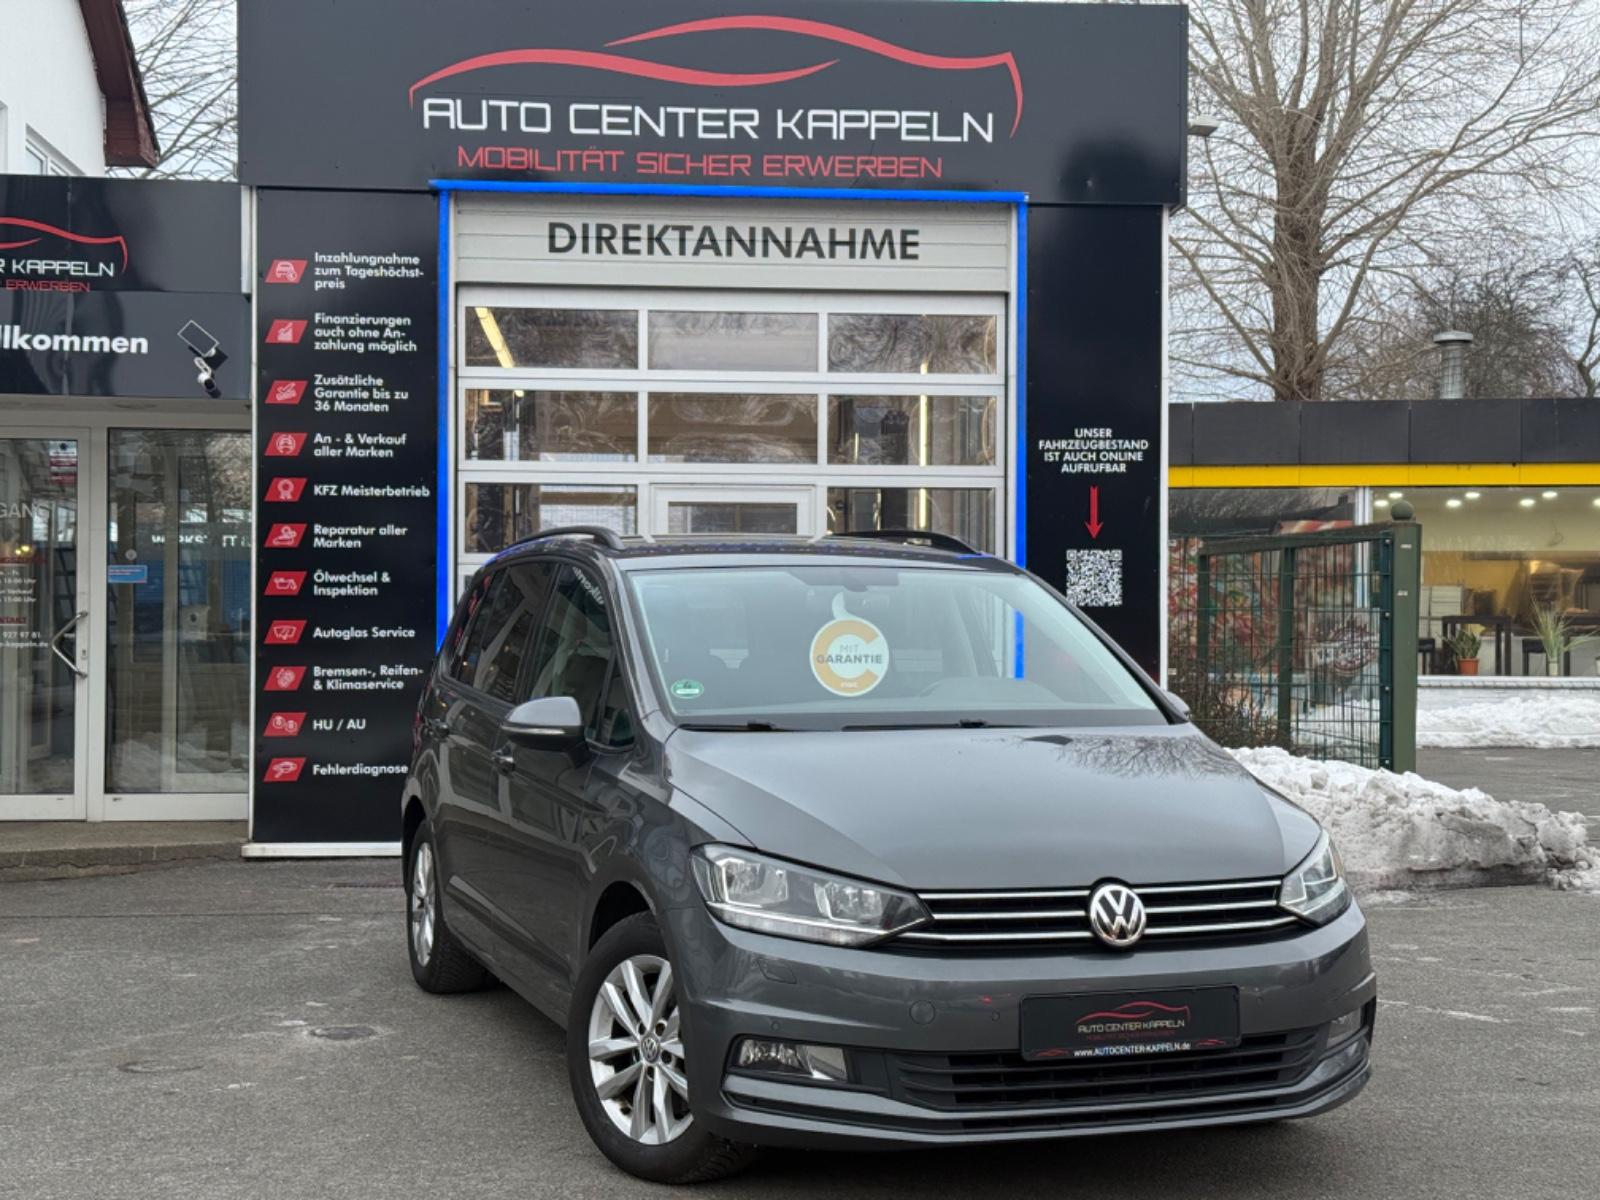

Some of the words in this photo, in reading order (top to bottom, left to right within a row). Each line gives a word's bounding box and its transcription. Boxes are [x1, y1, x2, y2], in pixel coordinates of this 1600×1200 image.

[423, 97, 551, 133] AUTO
[569, 103, 760, 139] CENTER
[776, 108, 993, 143] KAPPELN
[458, 146, 624, 172] MOBILITÄT
[636, 152, 751, 177] SICHER
[763, 155, 943, 178] ERWERBEN
[548, 222, 921, 261] DIREKTANNAHME
[314, 252, 420, 266] Inzahlungnahme
[12, 258, 114, 277] KAPPELN
[314, 267, 341, 276] zum
[345, 265, 424, 278] Tageshöchst-
[6, 280, 90, 292] ERWERBEN
[314, 278, 345, 291] preis
[314, 313, 411, 327] Finanzierungen
[314, 326, 345, 337] auch
[348, 327, 380, 337] ohne
[383, 328, 406, 338] An-
[314, 339, 365, 353] zahlung
[368, 340, 417, 354] möglich
[314, 374, 384, 386] Zusätzliche
[314, 387, 370, 399] Garantie
[373, 388, 390, 399] bis
[394, 390, 409, 399] zu
[314, 401, 331, 412] 36
[334, 401, 389, 412] Monaten
[314, 433, 332, 444] An
[344, 434, 354, 444] &
[357, 433, 407, 445] Verkauf
[1074, 428, 1113, 438] UNSER
[1038, 439, 1149, 450] FAHRZEUGBESTAND
[314, 446, 343, 457] aller
[345, 448, 394, 458] Marken
[1044, 451, 1060, 462] IST
[1063, 451, 1096, 462] AUCH
[1100, 451, 1143, 462] ONLINE
[1061, 463, 1127, 473] AUFRUFBAR
[314, 485, 338, 497] KFZ
[341, 485, 431, 497] Meisterbetrieb
[314, 524, 376, 537] Reparatur
[378, 525, 408, 536] aller
[313, 538, 362, 548] Marken
[314, 569, 378, 583] Ölwechsel
[381, 572, 391, 583] &
[313, 585, 379, 598] Inspektion
[313, 627, 368, 640] Autoglas
[372, 627, 416, 638] Service
[815, 654, 882, 664] GARANTIE
[313, 666, 376, 678] Bremsen-,
[379, 665, 424, 676] Reifen-
[313, 680, 323, 690] &
[326, 679, 405, 690] Klimaservice
[312, 719, 333, 730] HU
[336, 719, 344, 731] /
[346, 719, 366, 730] AU
[312, 764, 409, 777] Fehlerdiagnose
[1077, 1023, 1104, 1034] AUTO
[1105, 1021, 1141, 1032] CENTER
[1142, 1019, 1185, 1030] KAPPELN
